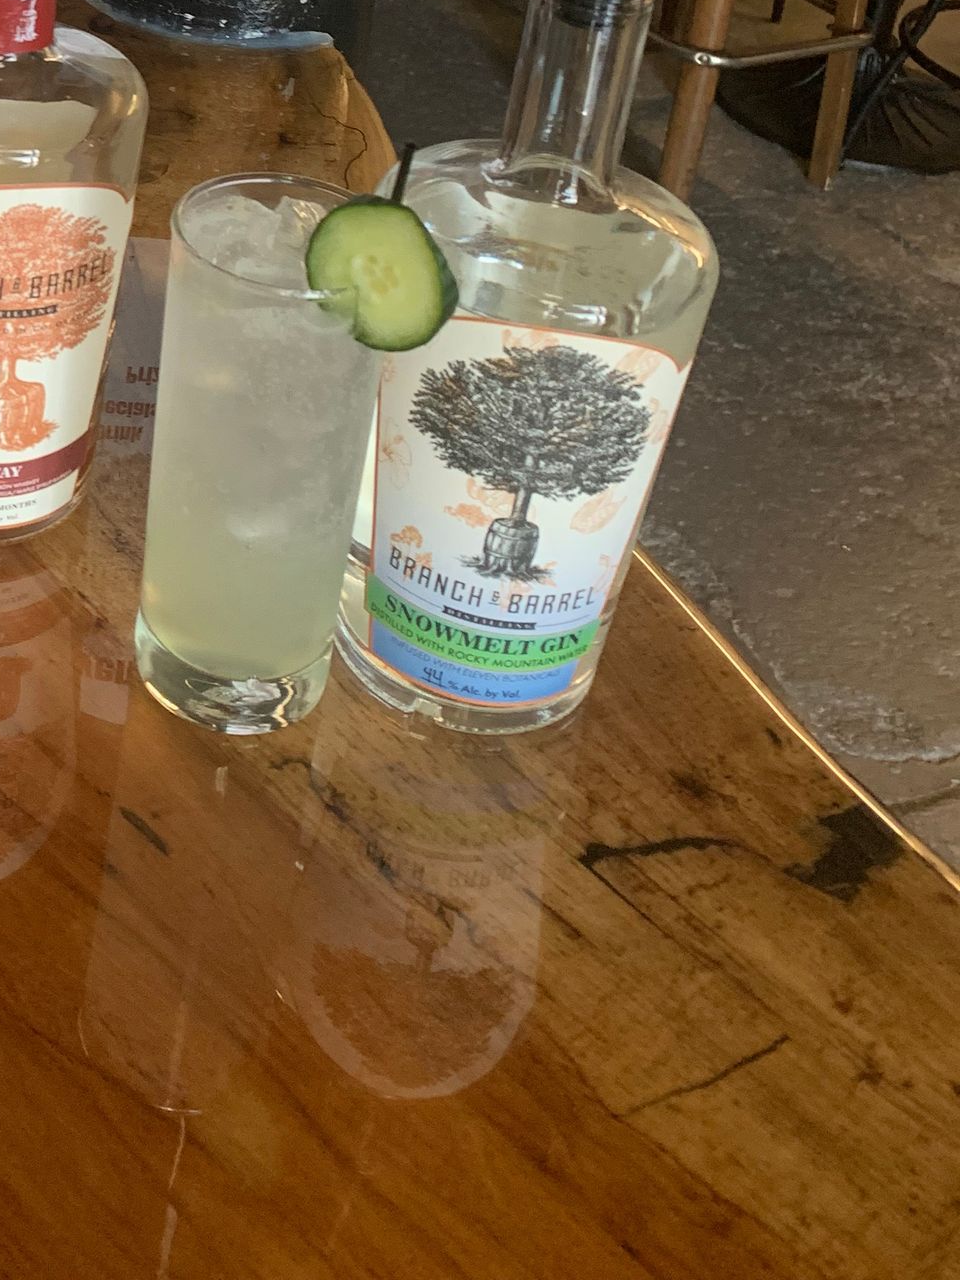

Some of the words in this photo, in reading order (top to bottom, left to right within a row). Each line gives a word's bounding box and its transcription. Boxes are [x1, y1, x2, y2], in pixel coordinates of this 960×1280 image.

[29, 253, 109, 299] BARREL
[389, 545, 484, 608] BRANCH
[507, 586, 594, 615] BARREL
[371, 604, 414, 638] DISTILLED
[415, 635, 445, 654] WITH
[447, 647, 490, 666] ROCKY
[493, 655, 556, 669] MOUNTAIN
[384, 593, 536, 656] SNOWMELT
[540, 630, 582, 654] GIN
[445, 606, 536, 630] DISTILLING
[460, 684, 480, 696] Alc.
[484, 688, 497, 699] by
[501, 689, 521, 699] Vol.
